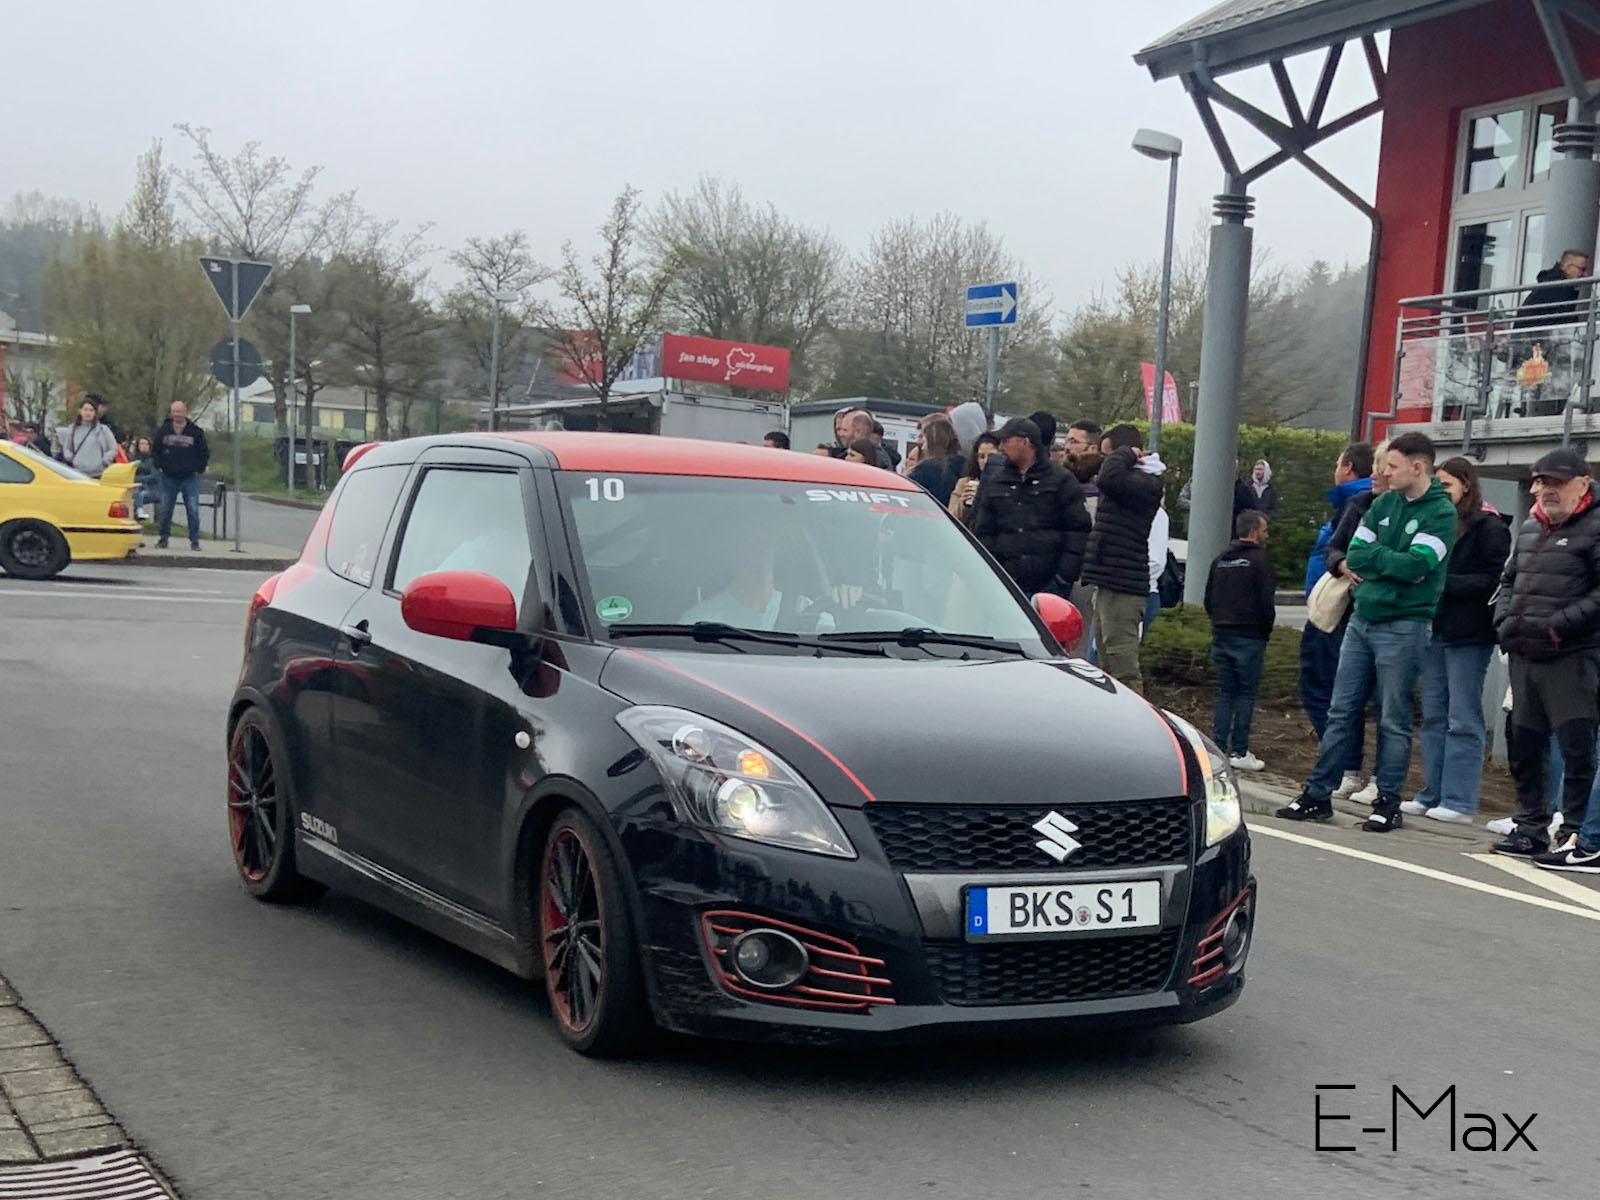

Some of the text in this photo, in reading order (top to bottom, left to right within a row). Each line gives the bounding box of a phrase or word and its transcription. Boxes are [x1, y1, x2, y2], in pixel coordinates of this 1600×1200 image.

[678, 352, 720, 367] fan shop
[585, 478, 624, 501] 10
[805, 489, 910, 508] SWIFT
[608, 598, 619, 608] 4
[300, 811, 338, 844] SUZUKI
[1010, 888, 1137, 928] BKS S1
